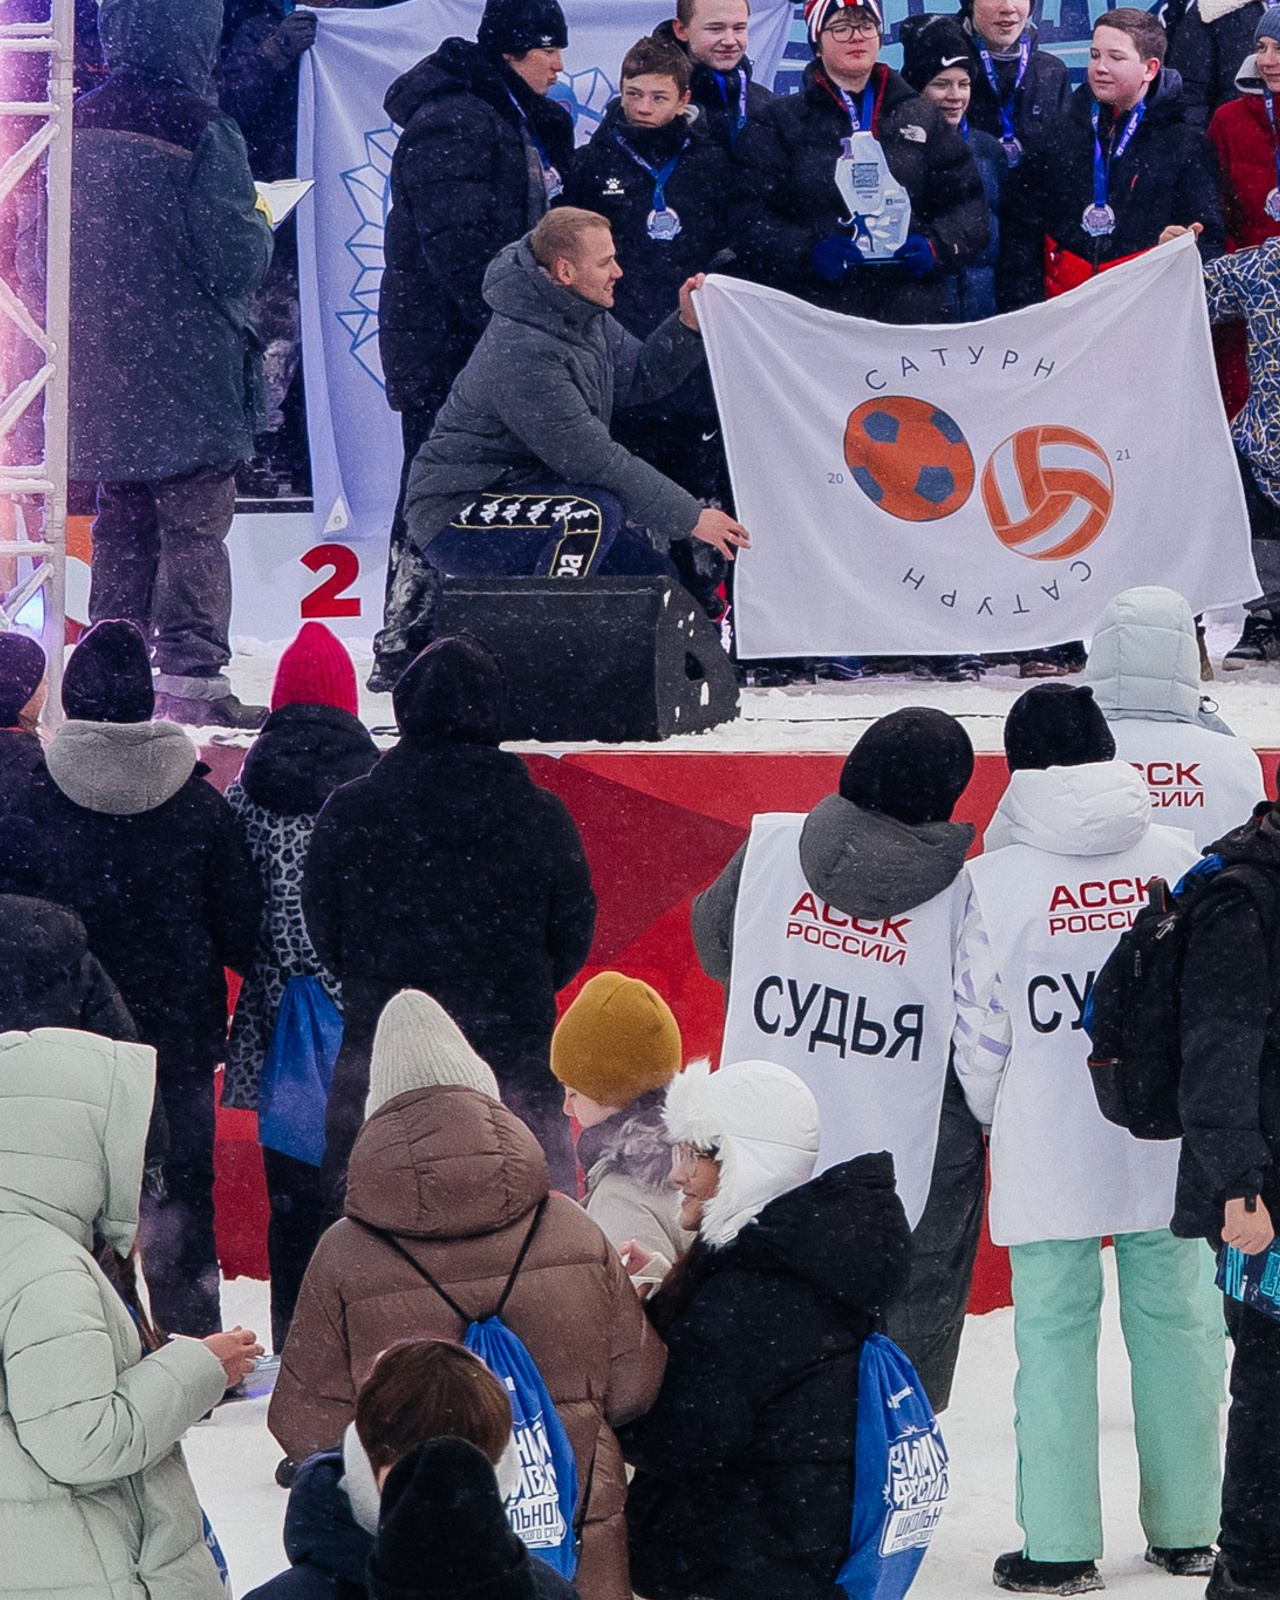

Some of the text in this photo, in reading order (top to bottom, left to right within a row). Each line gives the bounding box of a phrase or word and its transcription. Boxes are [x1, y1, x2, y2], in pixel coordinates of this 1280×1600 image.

[864, 345, 1056, 391] САТУРН
[1115, 448, 1132, 462] 21
[827, 472, 845, 485] 20
[300, 544, 362, 618] 2
[901, 560, 1093, 616] САТУРН
[1130, 762, 1204, 786] СК
[1149, 791, 1205, 807] СИИ
[786, 921, 907, 966] РОССИИ
[1049, 911, 1134, 936] РОСС
[753, 975, 925, 1062] СУДЬЯ
[1027, 970, 1096, 1034] СУ
